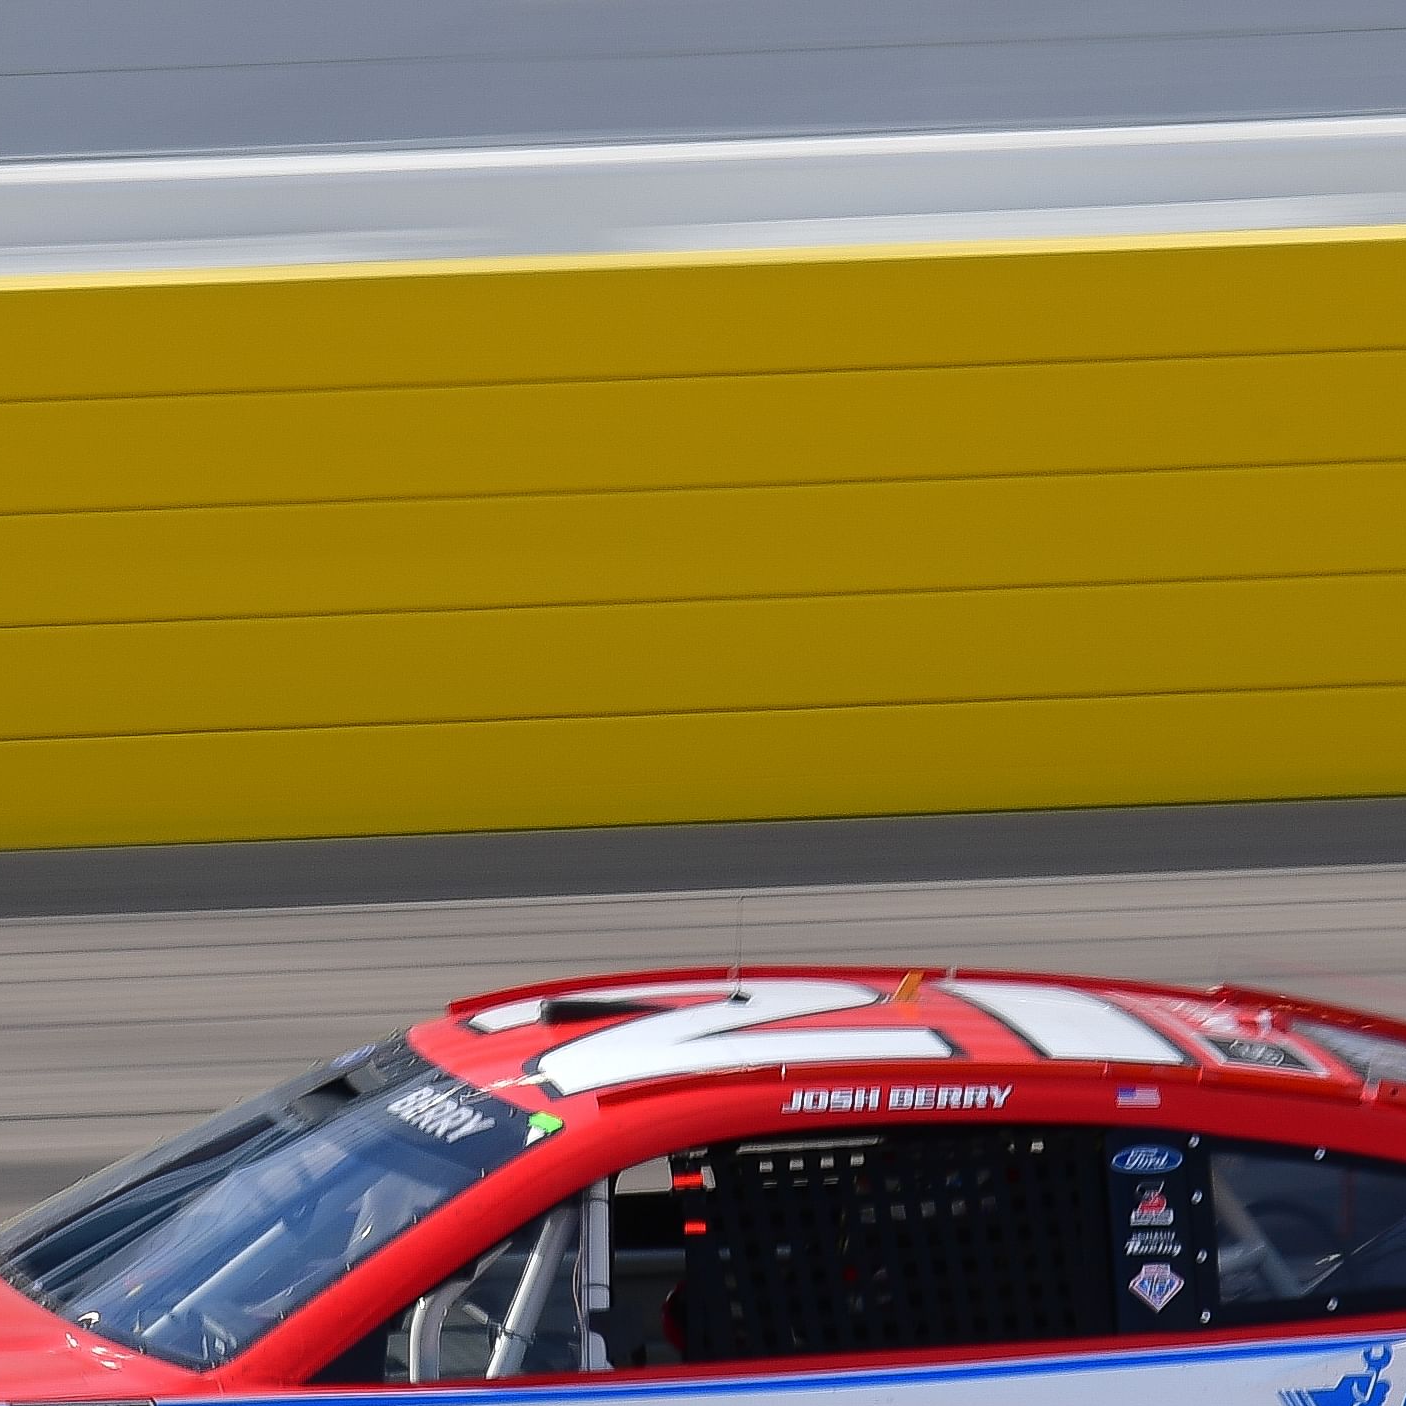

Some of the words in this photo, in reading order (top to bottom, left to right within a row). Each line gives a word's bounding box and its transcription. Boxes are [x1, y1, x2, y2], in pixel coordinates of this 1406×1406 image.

[466, 977, 1186, 1098] 21
[780, 1086, 881, 1115] JOSH
[887, 1083, 1014, 1112] BERRY
